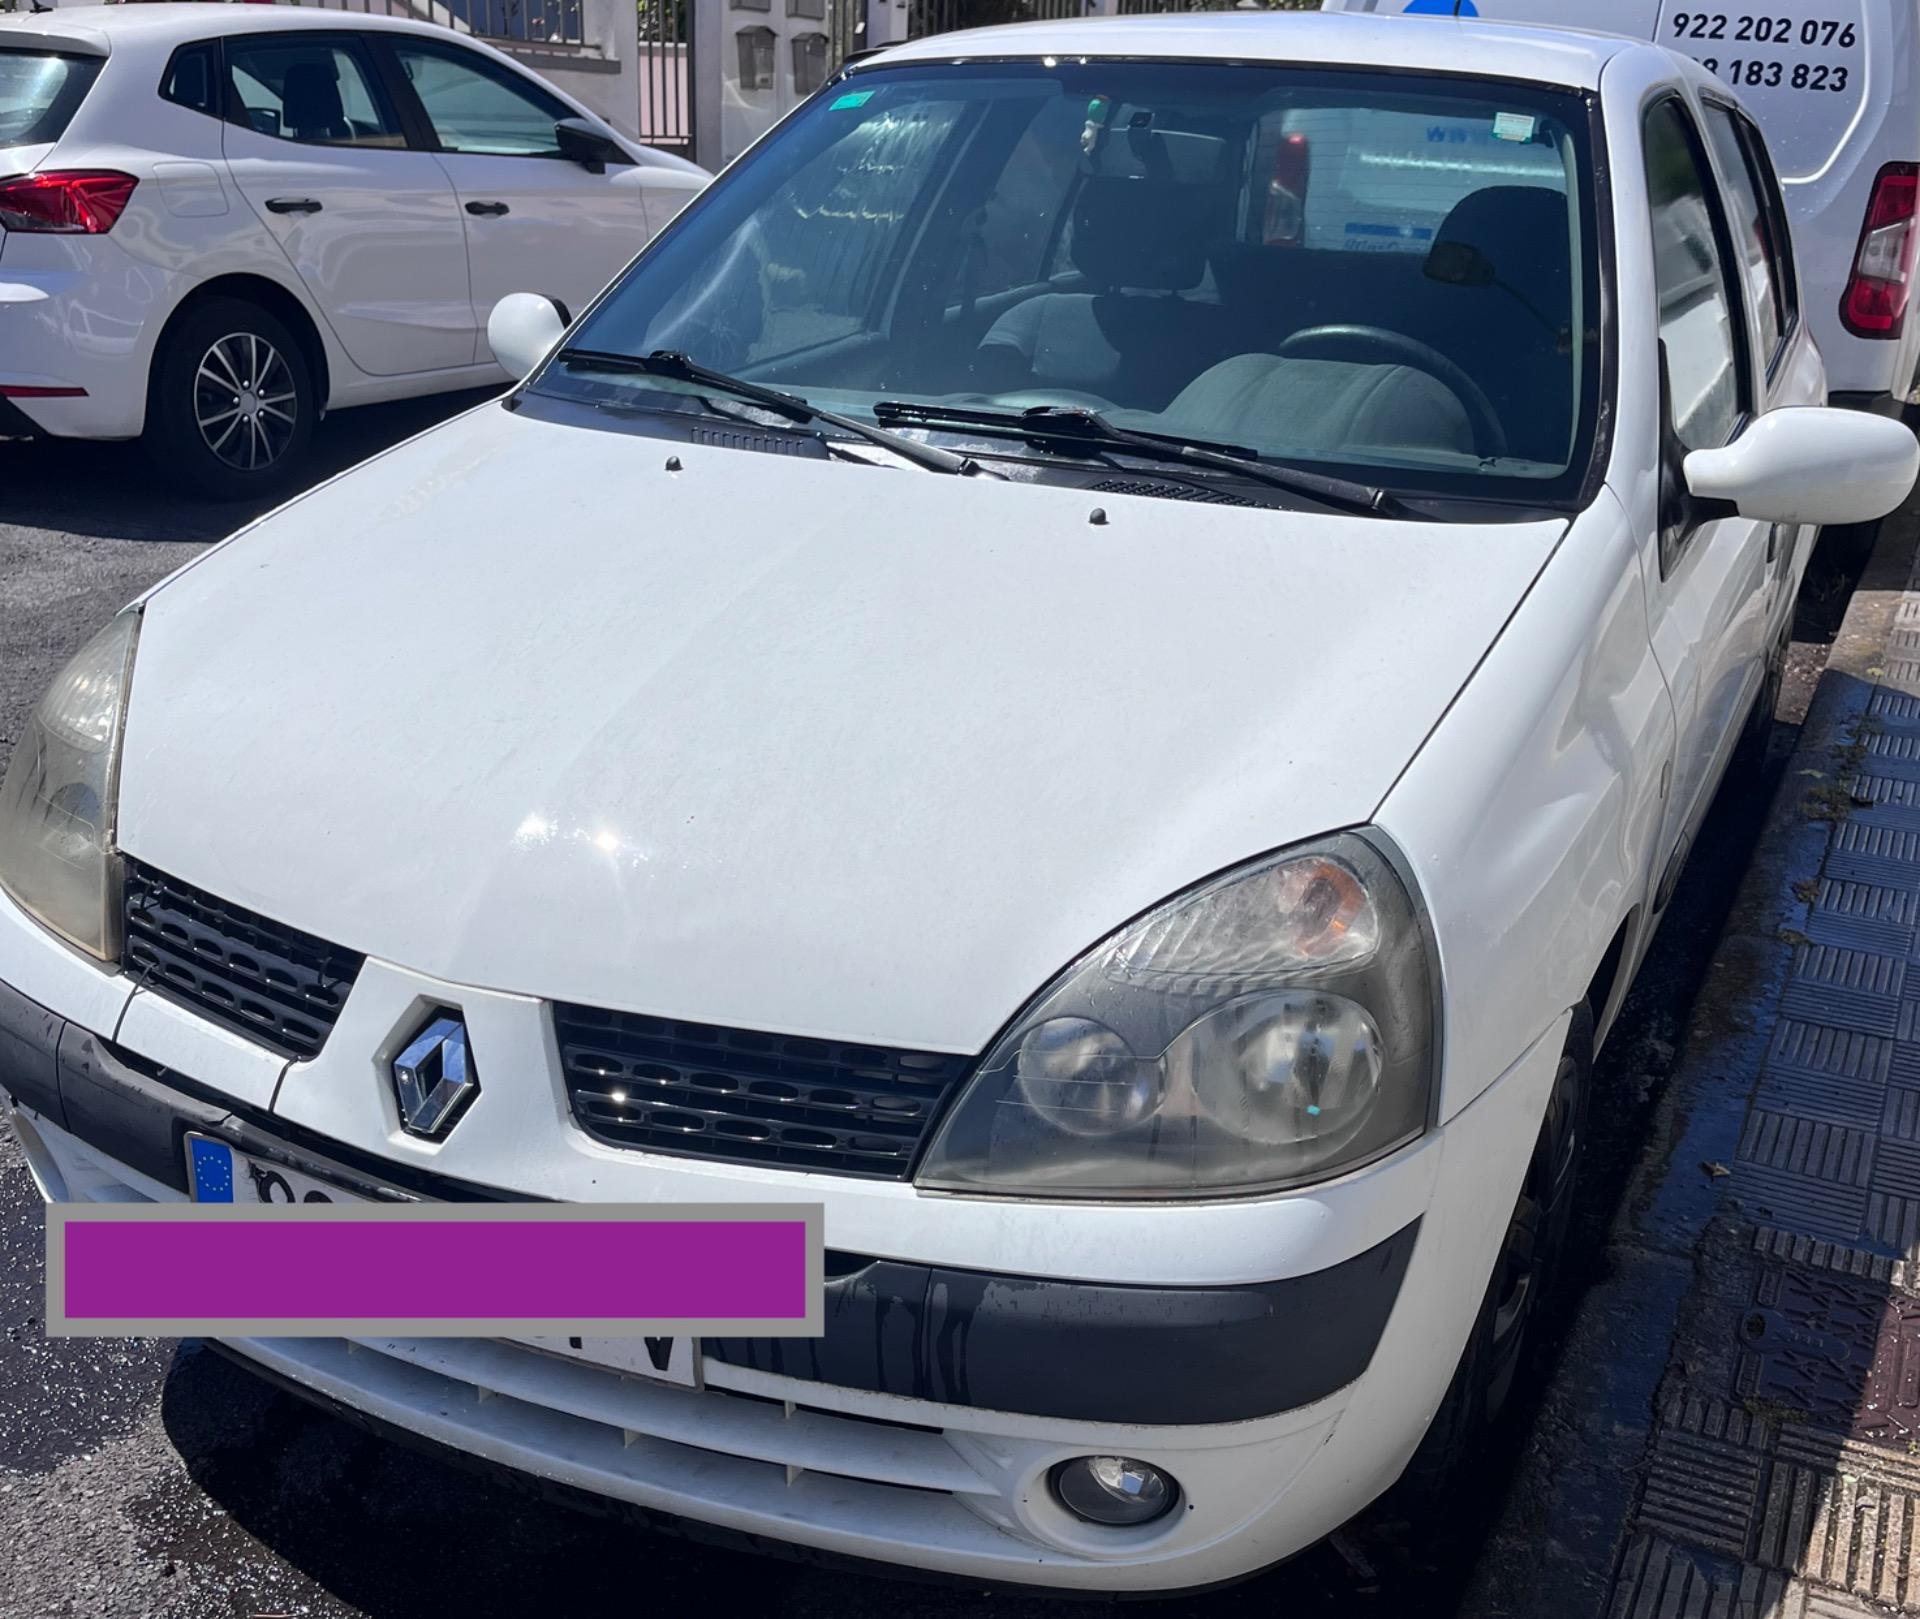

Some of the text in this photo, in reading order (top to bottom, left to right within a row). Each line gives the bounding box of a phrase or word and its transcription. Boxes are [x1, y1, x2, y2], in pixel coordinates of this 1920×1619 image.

[1673, 13, 1856, 48] 922 202 076
[1729, 60, 1783, 87] 183
[1791, 63, 1848, 92] 823
